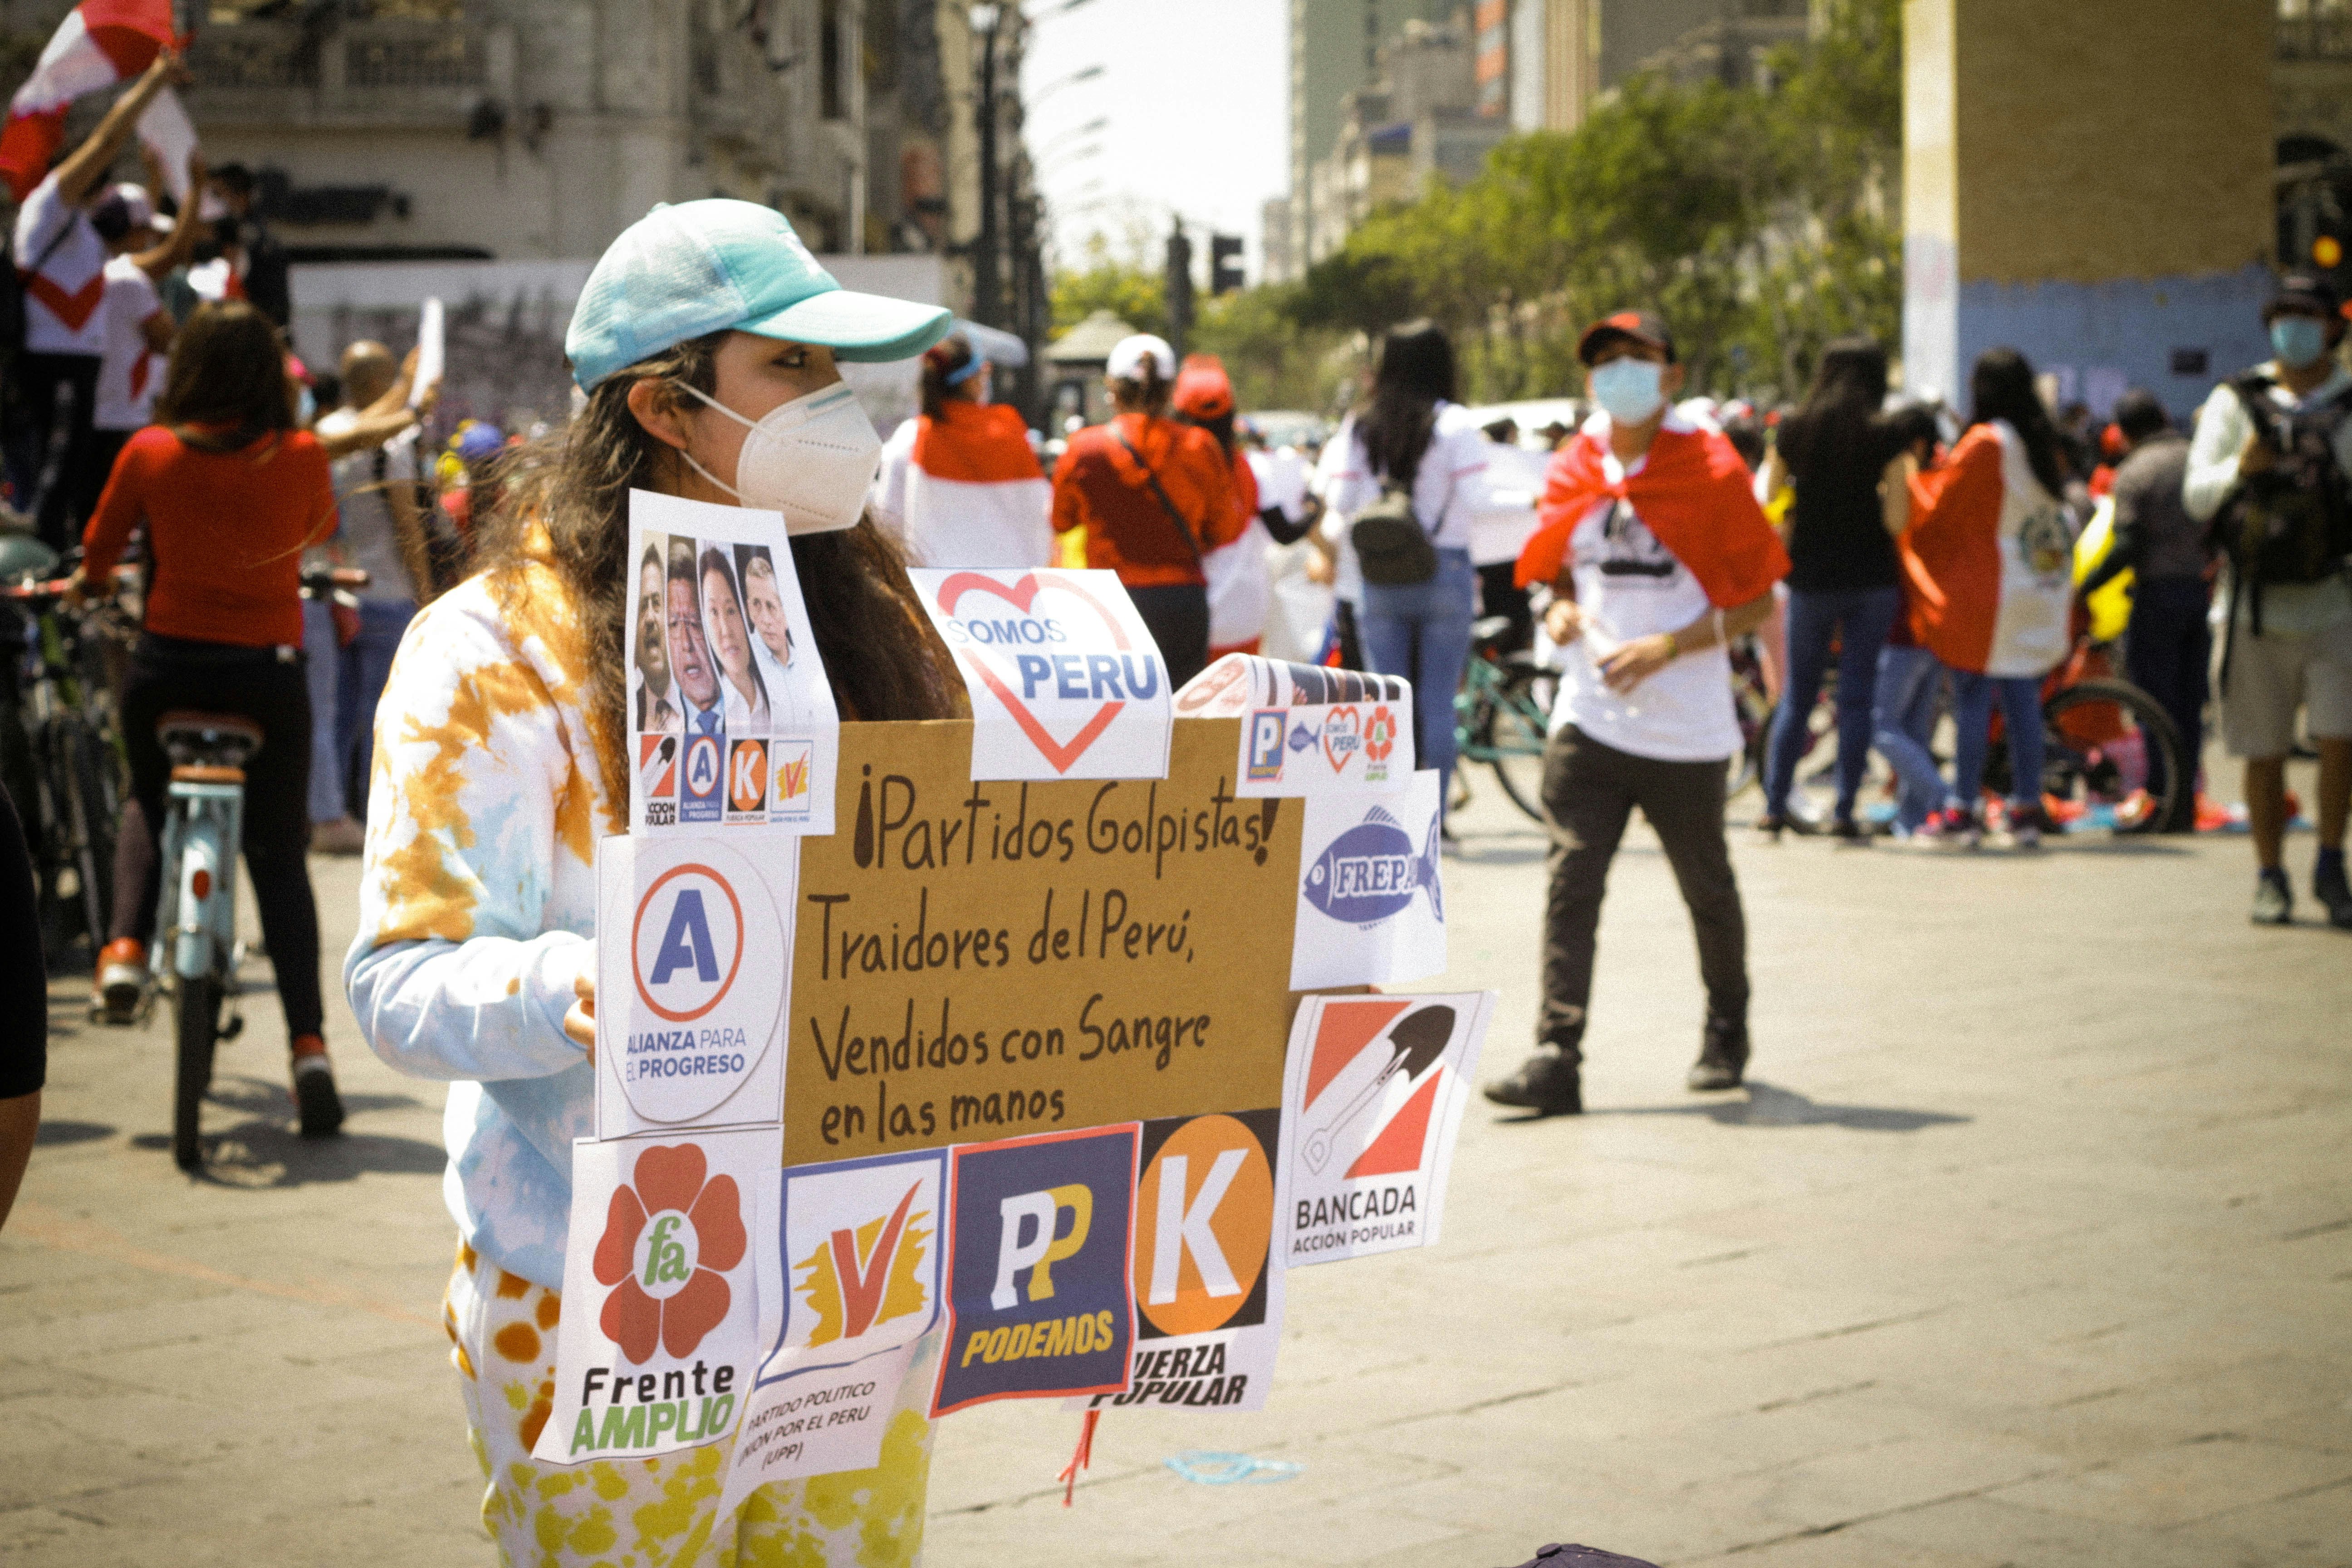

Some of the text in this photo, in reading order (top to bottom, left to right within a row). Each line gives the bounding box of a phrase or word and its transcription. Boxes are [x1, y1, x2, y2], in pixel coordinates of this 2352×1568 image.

[946, 618, 1067, 644] SOMOS
[1017, 654, 1158, 700] PERU
[692, 745, 712, 783] A
[733, 750, 765, 801] K
[853, 764, 1282, 879] ¡Partidos Golpistas!
[651, 890, 719, 984] A
[807, 887, 1193, 980] Traidores del Perú,
[627, 1028, 747, 1055] ALIANZA PARA
[810, 993, 1211, 1082] Vendidos con Sangre
[639, 1053, 745, 1079] PROGRESO
[820, 1080, 1065, 1146] en las manos
[1148, 1148, 1249, 1306] K
[1296, 1185, 1416, 1230] BANCADA
[644, 1215, 691, 1286] fa
[1293, 1220, 1415, 1254] ACCIÓN POPULAR
[960, 1309, 1114, 1368] PODEMOS
[1134, 1343, 1225, 1380] UERZA
[583, 1361, 735, 1406] Frente
[748, 1381, 876, 1433] PARTIDO POLITICO
[570, 1394, 735, 1455] AMPLIO
[773, 1418, 805, 1441] POR
[806, 1414, 823, 1431] EL
[827, 1406, 871, 1427] PERU
